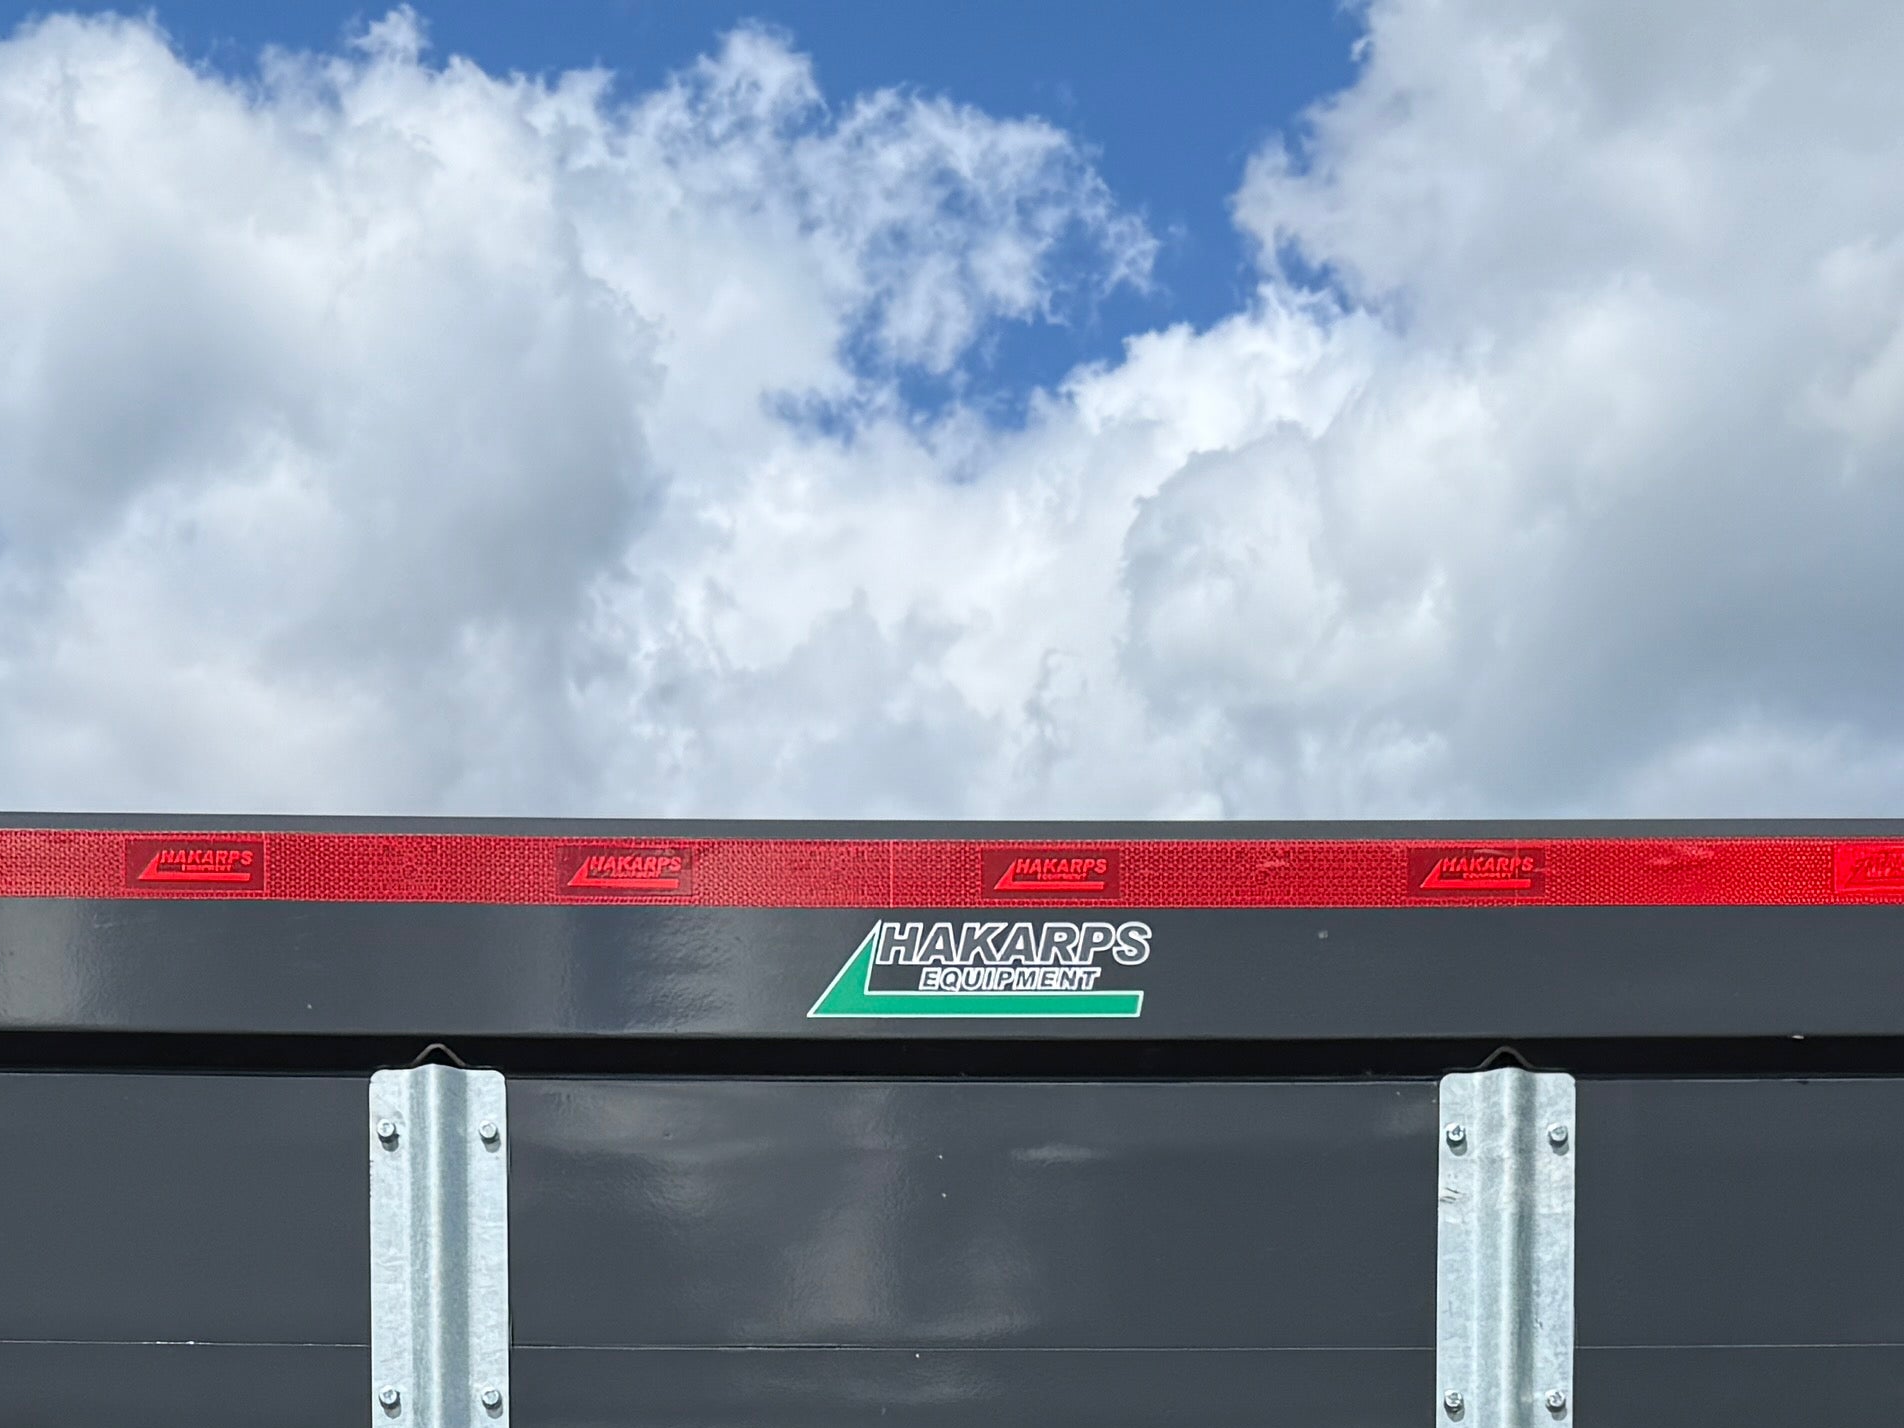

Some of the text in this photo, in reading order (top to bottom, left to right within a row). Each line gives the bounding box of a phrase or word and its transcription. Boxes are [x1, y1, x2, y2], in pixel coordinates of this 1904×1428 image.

[160, 850, 254, 865] HAKARPS
[590, 856, 682, 871] HAKARPS
[1442, 856, 1534, 871] HAKARPS
[1016, 858, 1107, 873] HAKARPS
[875, 921, 1152, 966] HAKARPS
[918, 967, 1102, 992] EQUIPMENT
